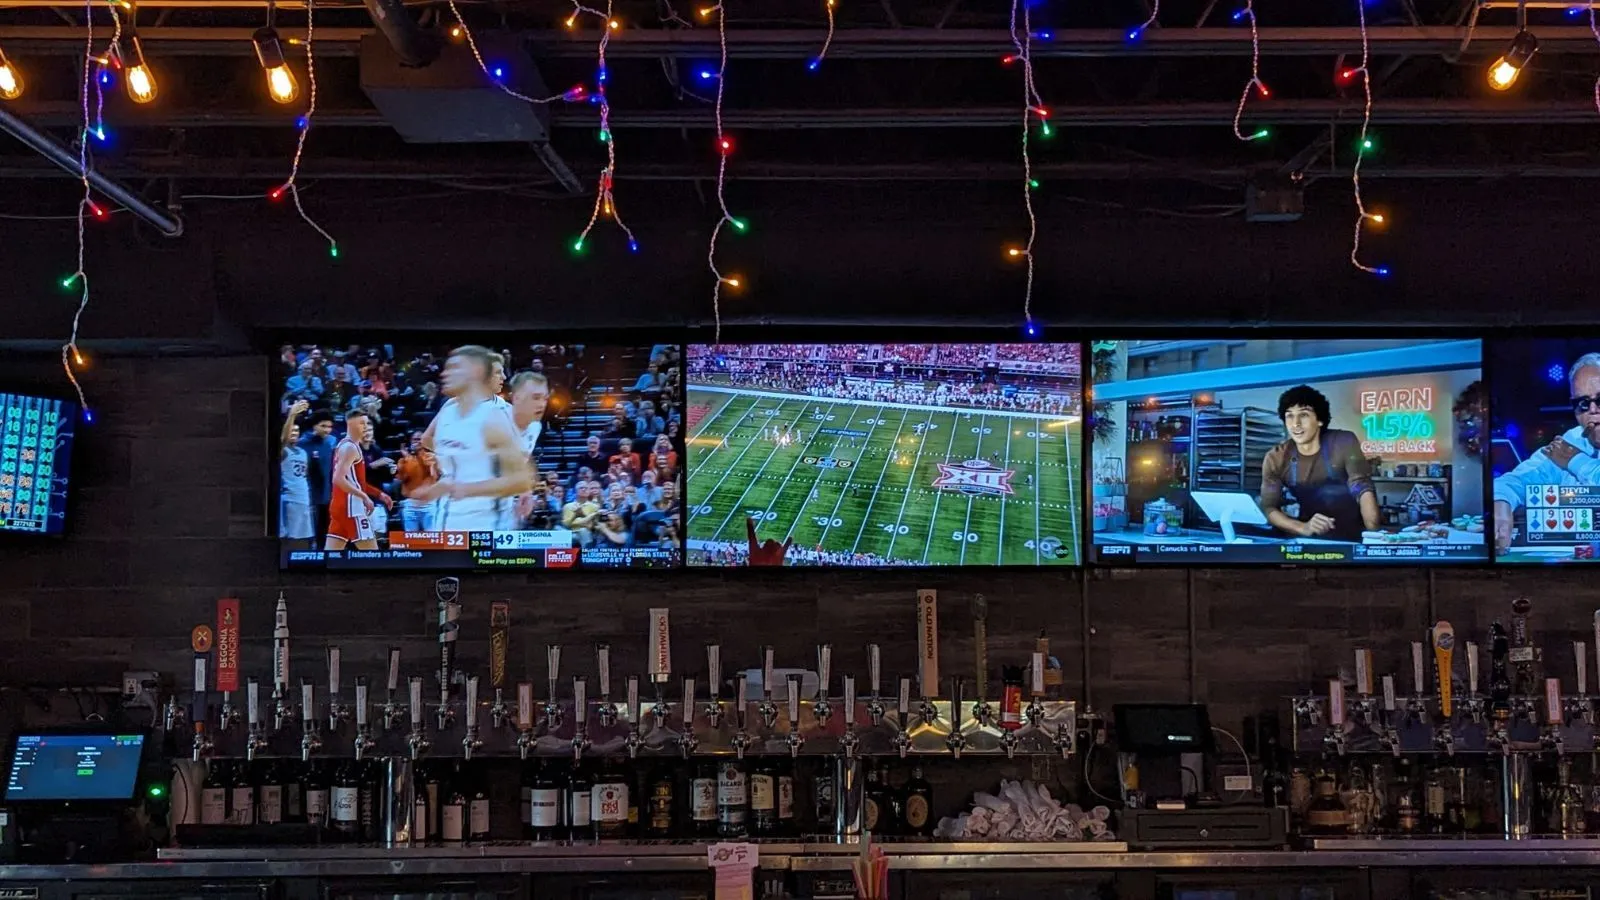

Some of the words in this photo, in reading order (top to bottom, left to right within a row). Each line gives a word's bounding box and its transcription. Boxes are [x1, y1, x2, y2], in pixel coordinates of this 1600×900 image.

[1361, 387, 1432, 414] EARN
[44, 411, 57, 422] 10
[42, 424, 56, 436] 20
[1362, 412, 1433, 440] 1.5%
[1361, 440, 1396, 453] CASH
[1397, 439, 1436, 453] BACK
[1528, 486, 1540, 494] 10
[1547, 486, 1554, 494] 4
[692, 505, 712, 514] 10
[1548, 510, 1554, 518] 9
[1562, 510, 1574, 518] 10
[1582, 510, 1588, 518] 8
[751, 510, 778, 521] 20
[360, 518, 369, 530] S
[817, 517, 842, 528] 30
[883, 524, 910, 535] 40
[447, 534, 464, 546] 32
[496, 534, 514, 545] 49
[952, 532, 978, 542] 50
[1024, 540, 1052, 552] 40
[1102, 546, 1131, 554] ESPN
[290, 552, 324, 560] ESPN2
[220, 628, 228, 668] BEGONIA
[228, 628, 237, 668] SANGRIA
